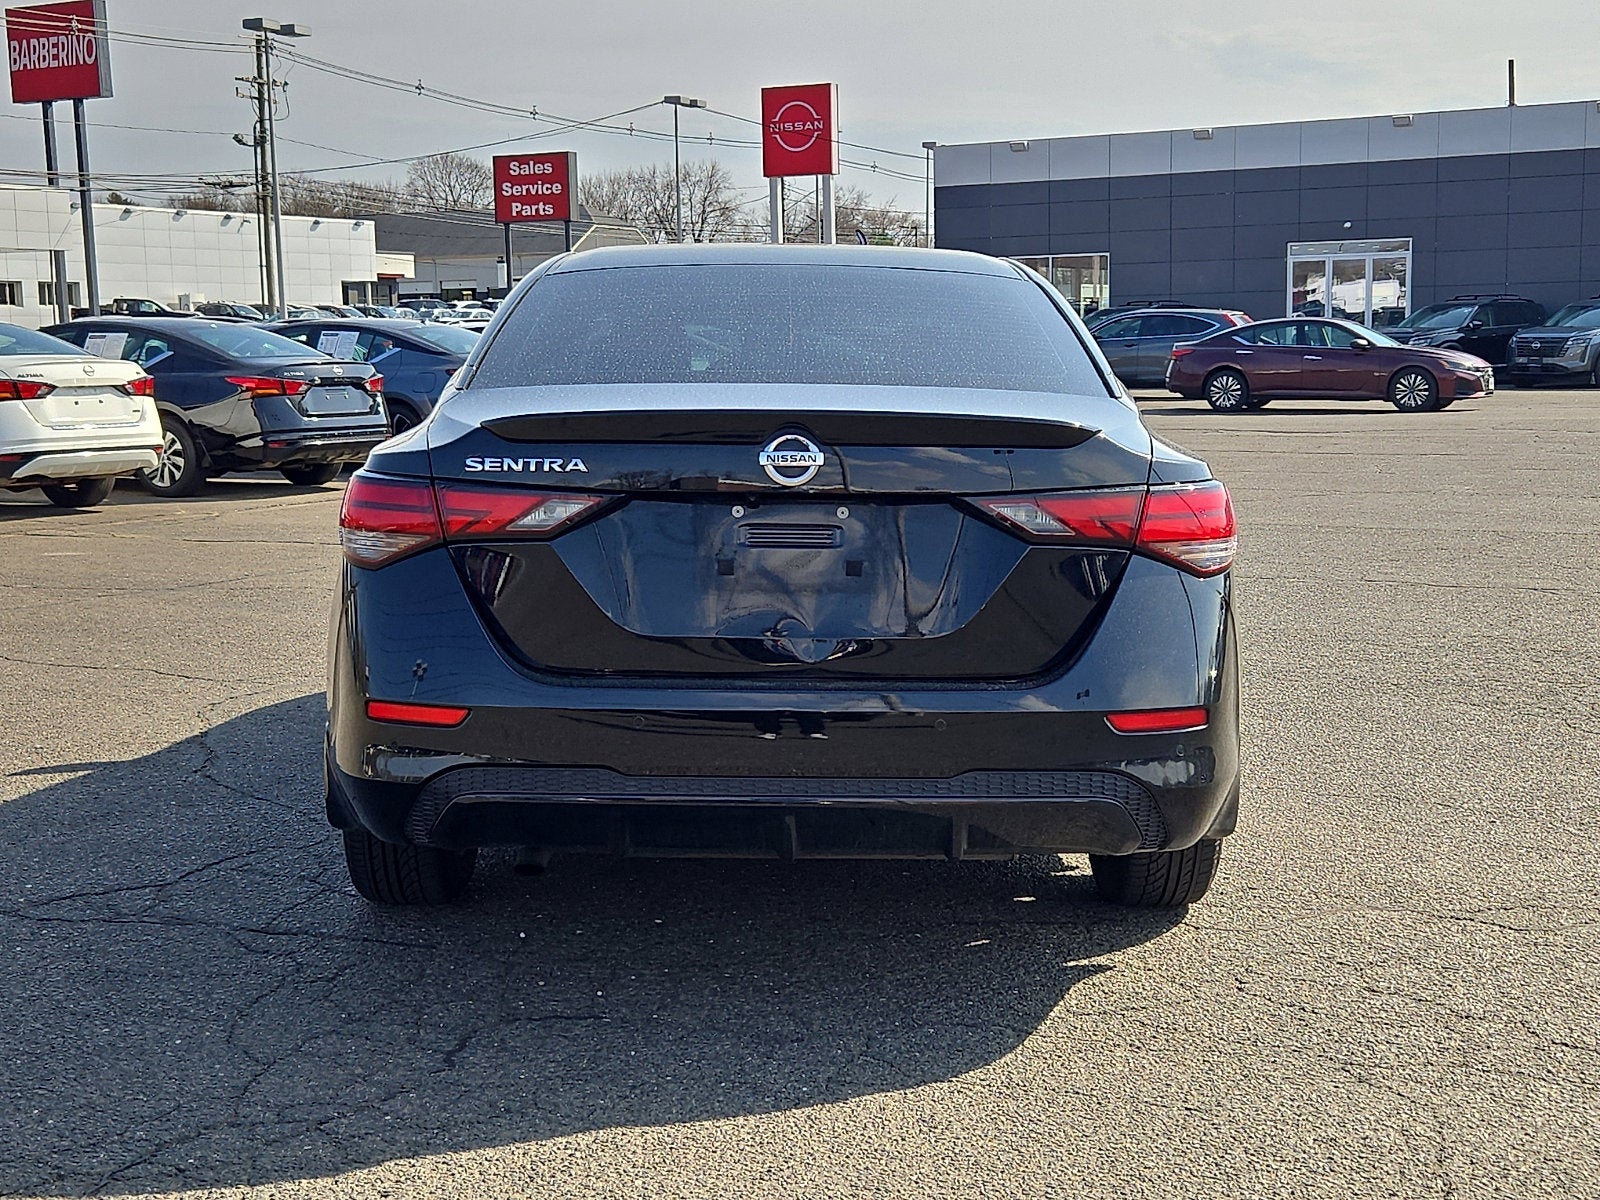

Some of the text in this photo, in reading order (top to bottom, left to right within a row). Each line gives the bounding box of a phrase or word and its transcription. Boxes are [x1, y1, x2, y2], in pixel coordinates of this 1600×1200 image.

[10, 33, 96, 72] BARBERINO
[770, 121, 824, 132] NISSAN
[509, 160, 553, 176] Sales
[501, 181, 562, 196] Service
[511, 202, 554, 216] Parts
[464, 457, 589, 472] SENTRA
[766, 454, 817, 463] NISSAN
